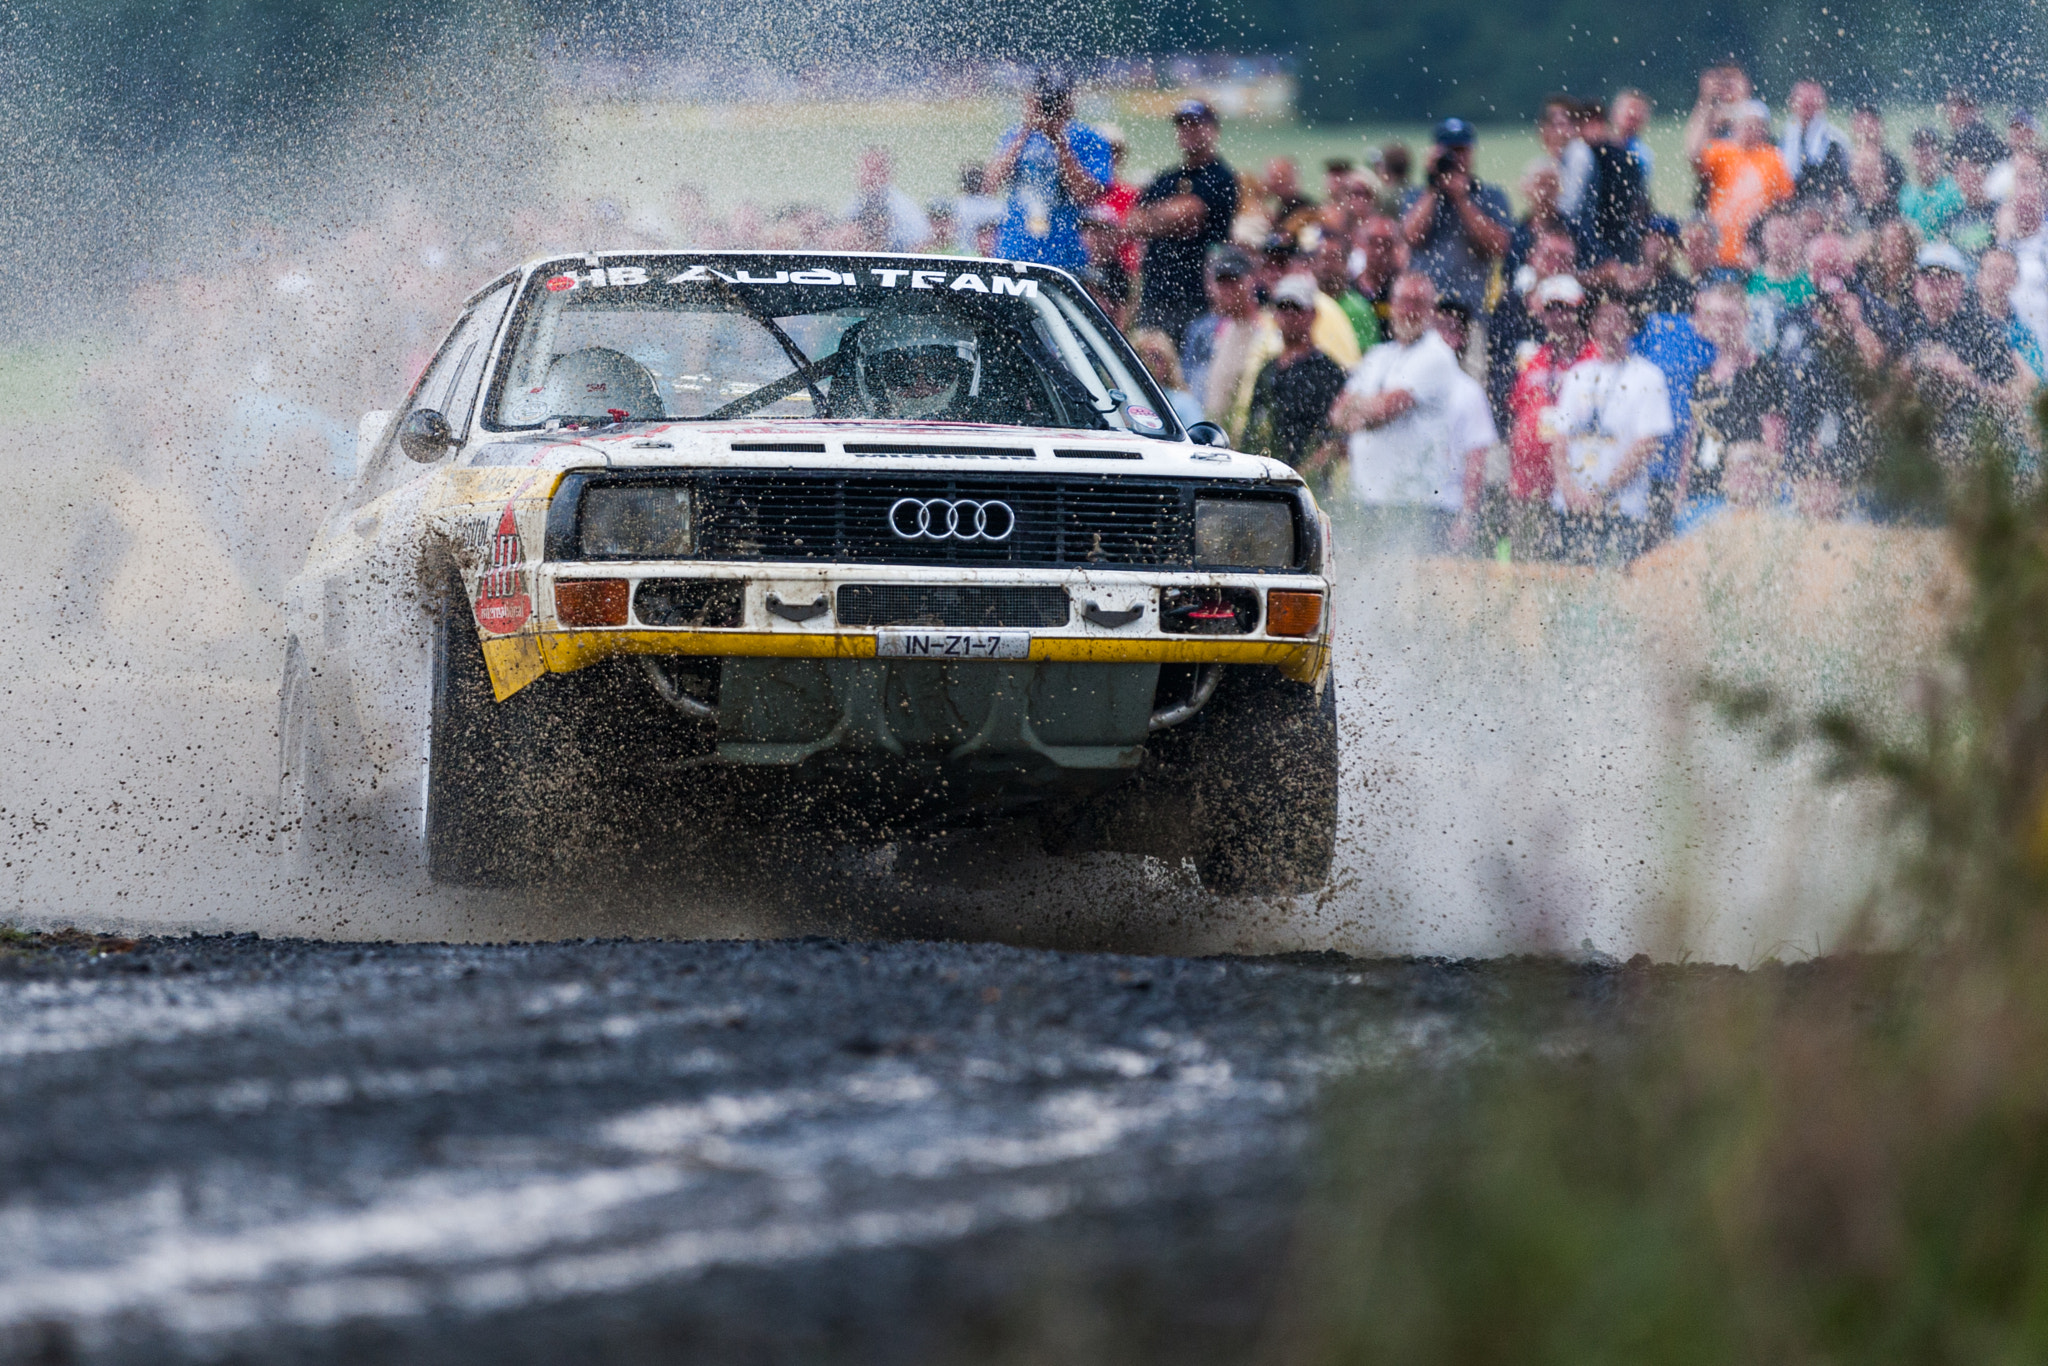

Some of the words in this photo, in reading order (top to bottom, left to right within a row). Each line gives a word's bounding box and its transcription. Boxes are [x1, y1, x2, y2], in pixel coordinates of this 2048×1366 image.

[563, 266, 650, 289] HB
[871, 268, 1039, 298] TEAM
[455, 515, 490, 548] strol
[905, 635, 1001, 656] IN-Z1-7
